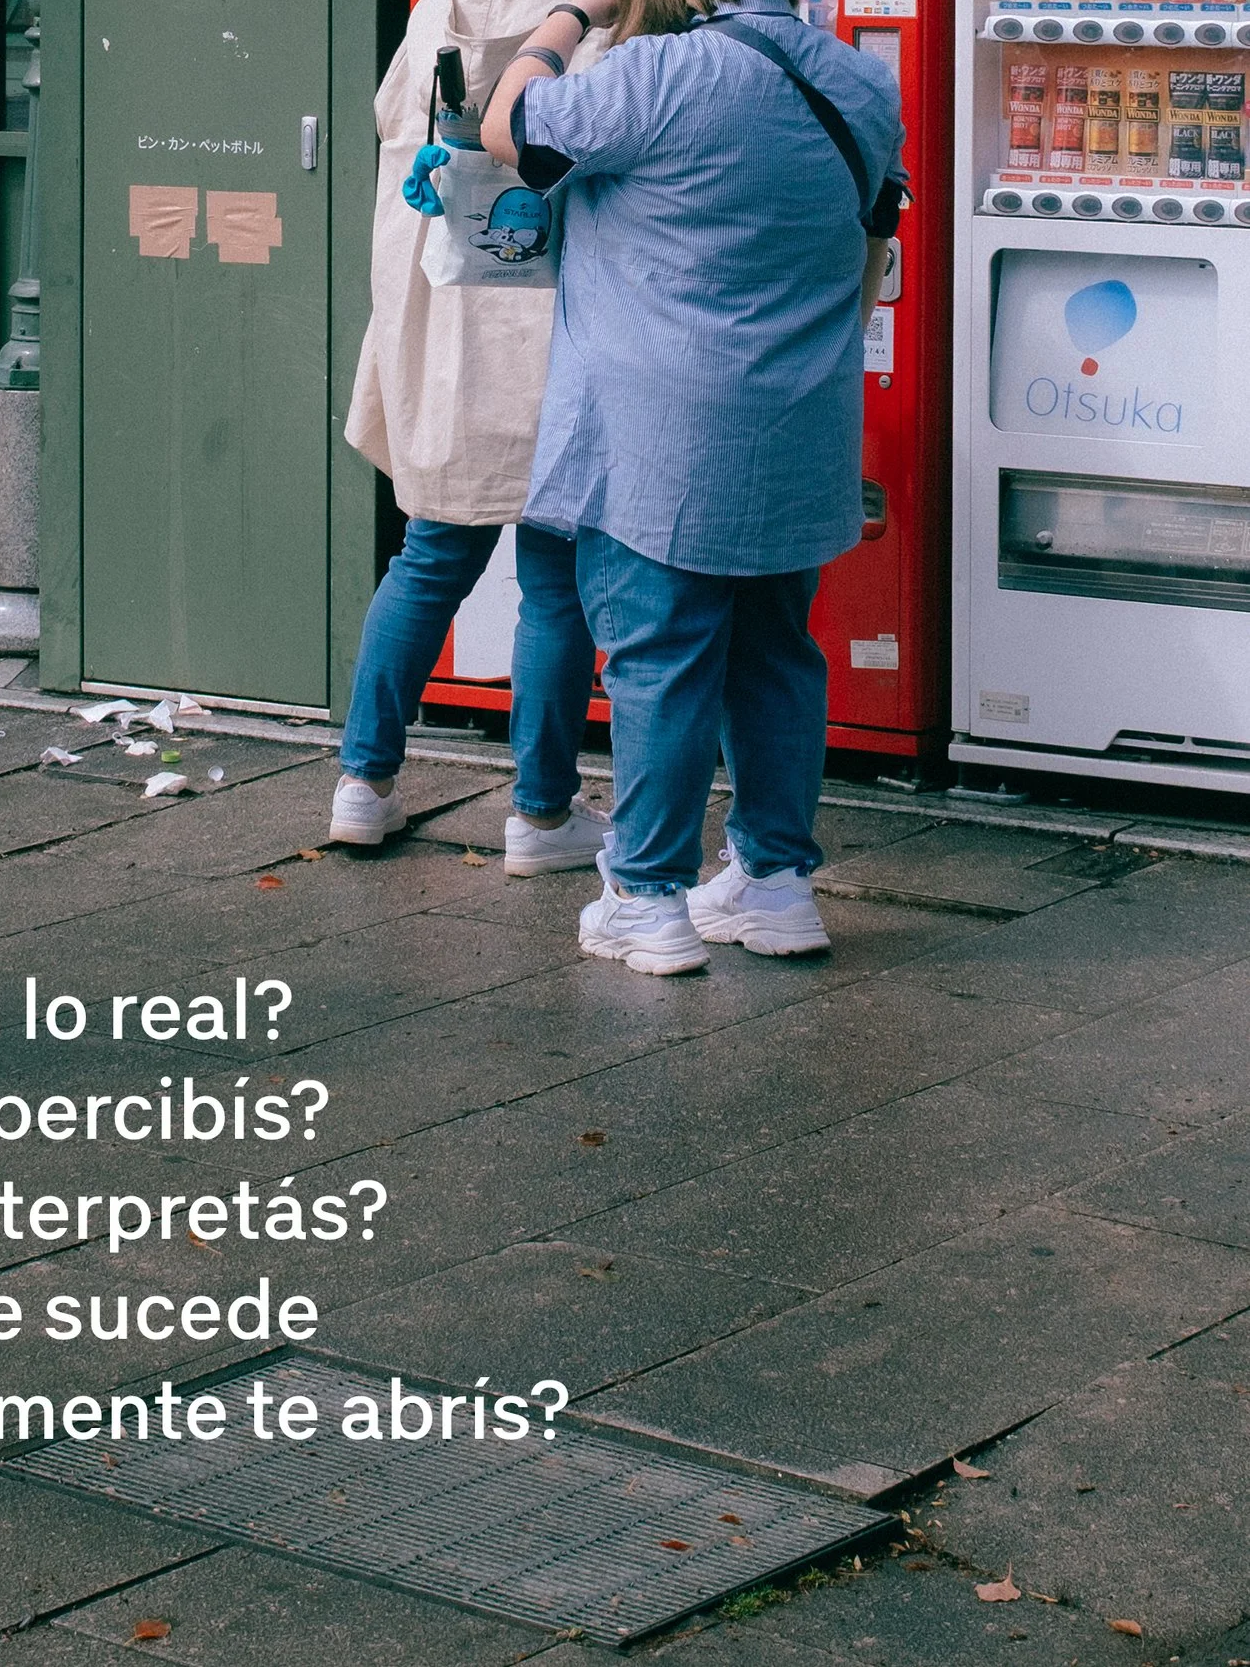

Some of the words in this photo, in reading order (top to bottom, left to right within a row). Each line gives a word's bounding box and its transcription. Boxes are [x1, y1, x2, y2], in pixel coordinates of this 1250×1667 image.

[1010, 101, 1040, 113] WONDA
[1056, 103, 1083, 114] WONDA
[1089, 106, 1117, 118] WONDA
[1127, 107, 1157, 119] WONDA
[1169, 110, 1201, 122] WONDA
[1206, 111, 1239, 122] WONDA
[138, 135, 264, 155] ビン・カン・ペットボトル
[1026, 377, 1182, 433] Otsuka
